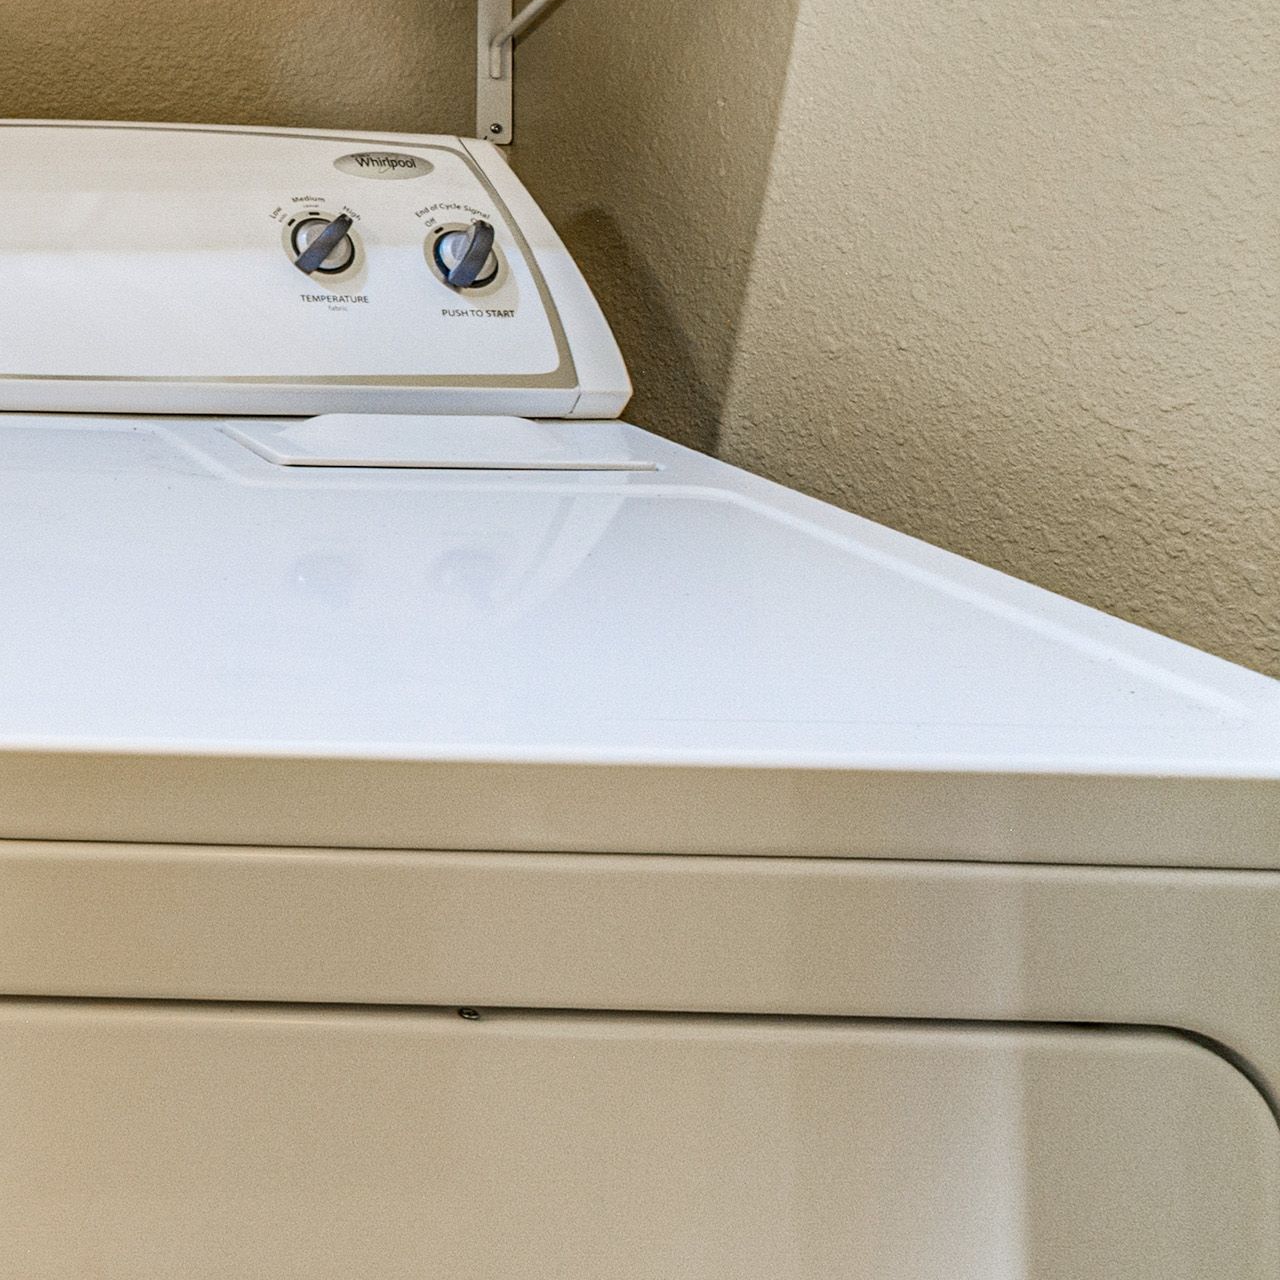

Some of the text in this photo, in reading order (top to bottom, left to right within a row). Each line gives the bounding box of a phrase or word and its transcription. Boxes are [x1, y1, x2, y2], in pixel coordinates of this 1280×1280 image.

[355, 157, 417, 170] Whirlpool
[300, 294, 369, 304] TEMPERATURE
[442, 309, 515, 318] PUSH TO START
